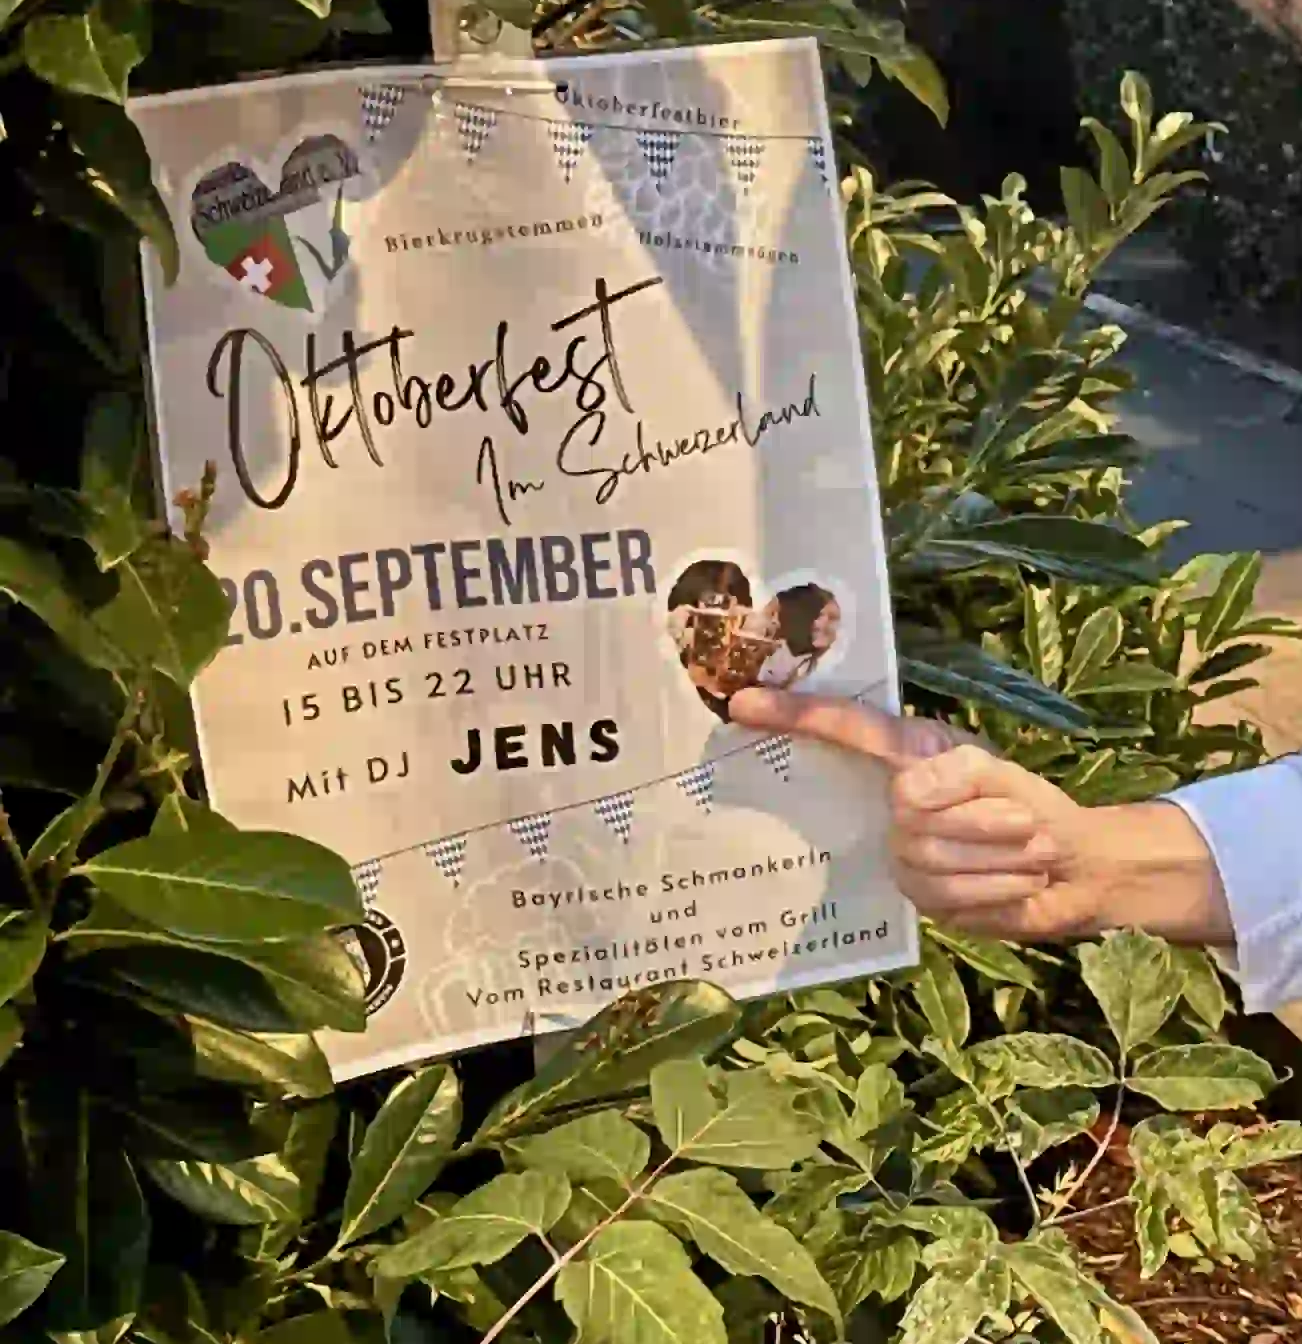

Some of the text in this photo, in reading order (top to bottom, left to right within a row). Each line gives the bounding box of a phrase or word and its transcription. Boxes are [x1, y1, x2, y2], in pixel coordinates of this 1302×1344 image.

[384, 212, 604, 253] Bierkrugstemmen
[206, 277, 664, 510] Oktoberfest
[475, 373, 821, 526] Im Schweizerland
[307, 623, 550, 671] AUF DEM FESTPLATZ
[282, 662, 573, 727] 15 BIS 22 UHR
[286, 718, 621, 803] Mit DJ JENS
[512, 878, 649, 908] Bayrische
[650, 899, 697, 924] und
[466, 920, 889, 1007] Vom Restaurant Schweizerland
[518, 901, 837, 971] Spezialitäten vom Grill
